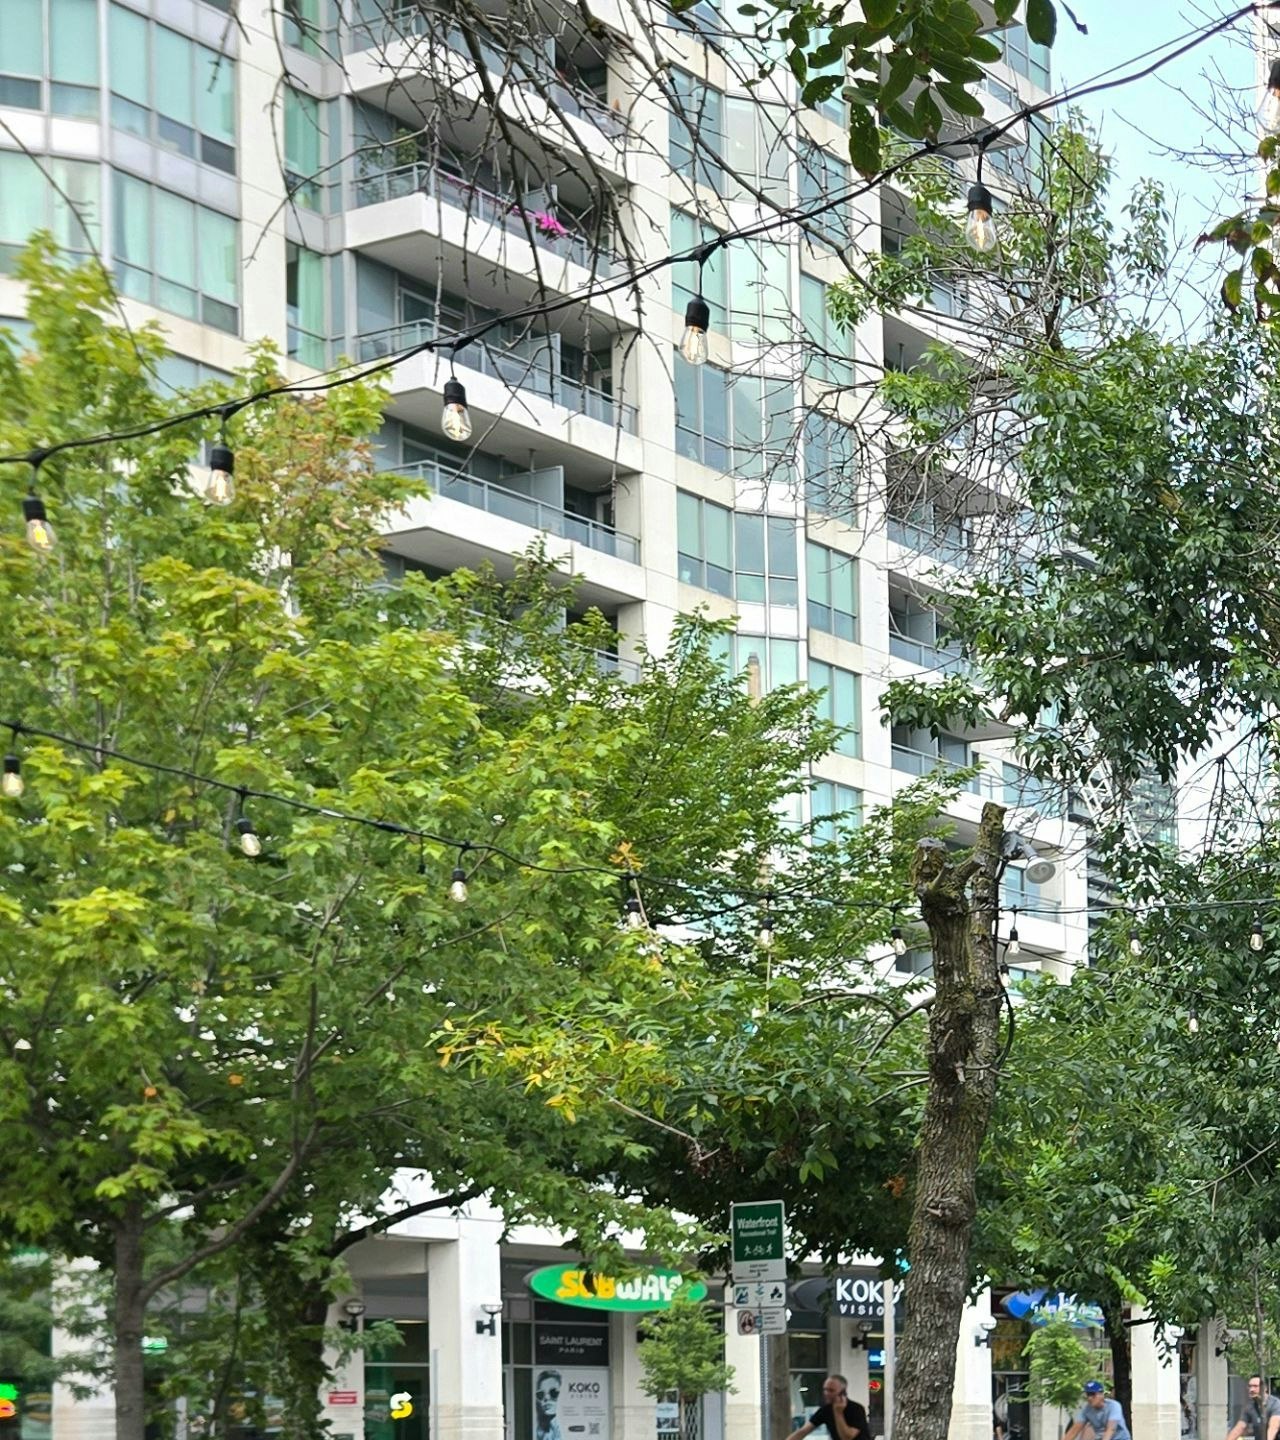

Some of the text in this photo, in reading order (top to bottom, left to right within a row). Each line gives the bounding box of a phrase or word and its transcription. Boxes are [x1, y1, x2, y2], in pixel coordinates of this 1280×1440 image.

[737, 1217, 778, 1229] Waterfront
[839, 1304, 896, 1315] VISIO
[540, 1336, 603, 1346] SAINT LAURENT
[568, 1382, 600, 1393] KOKO
